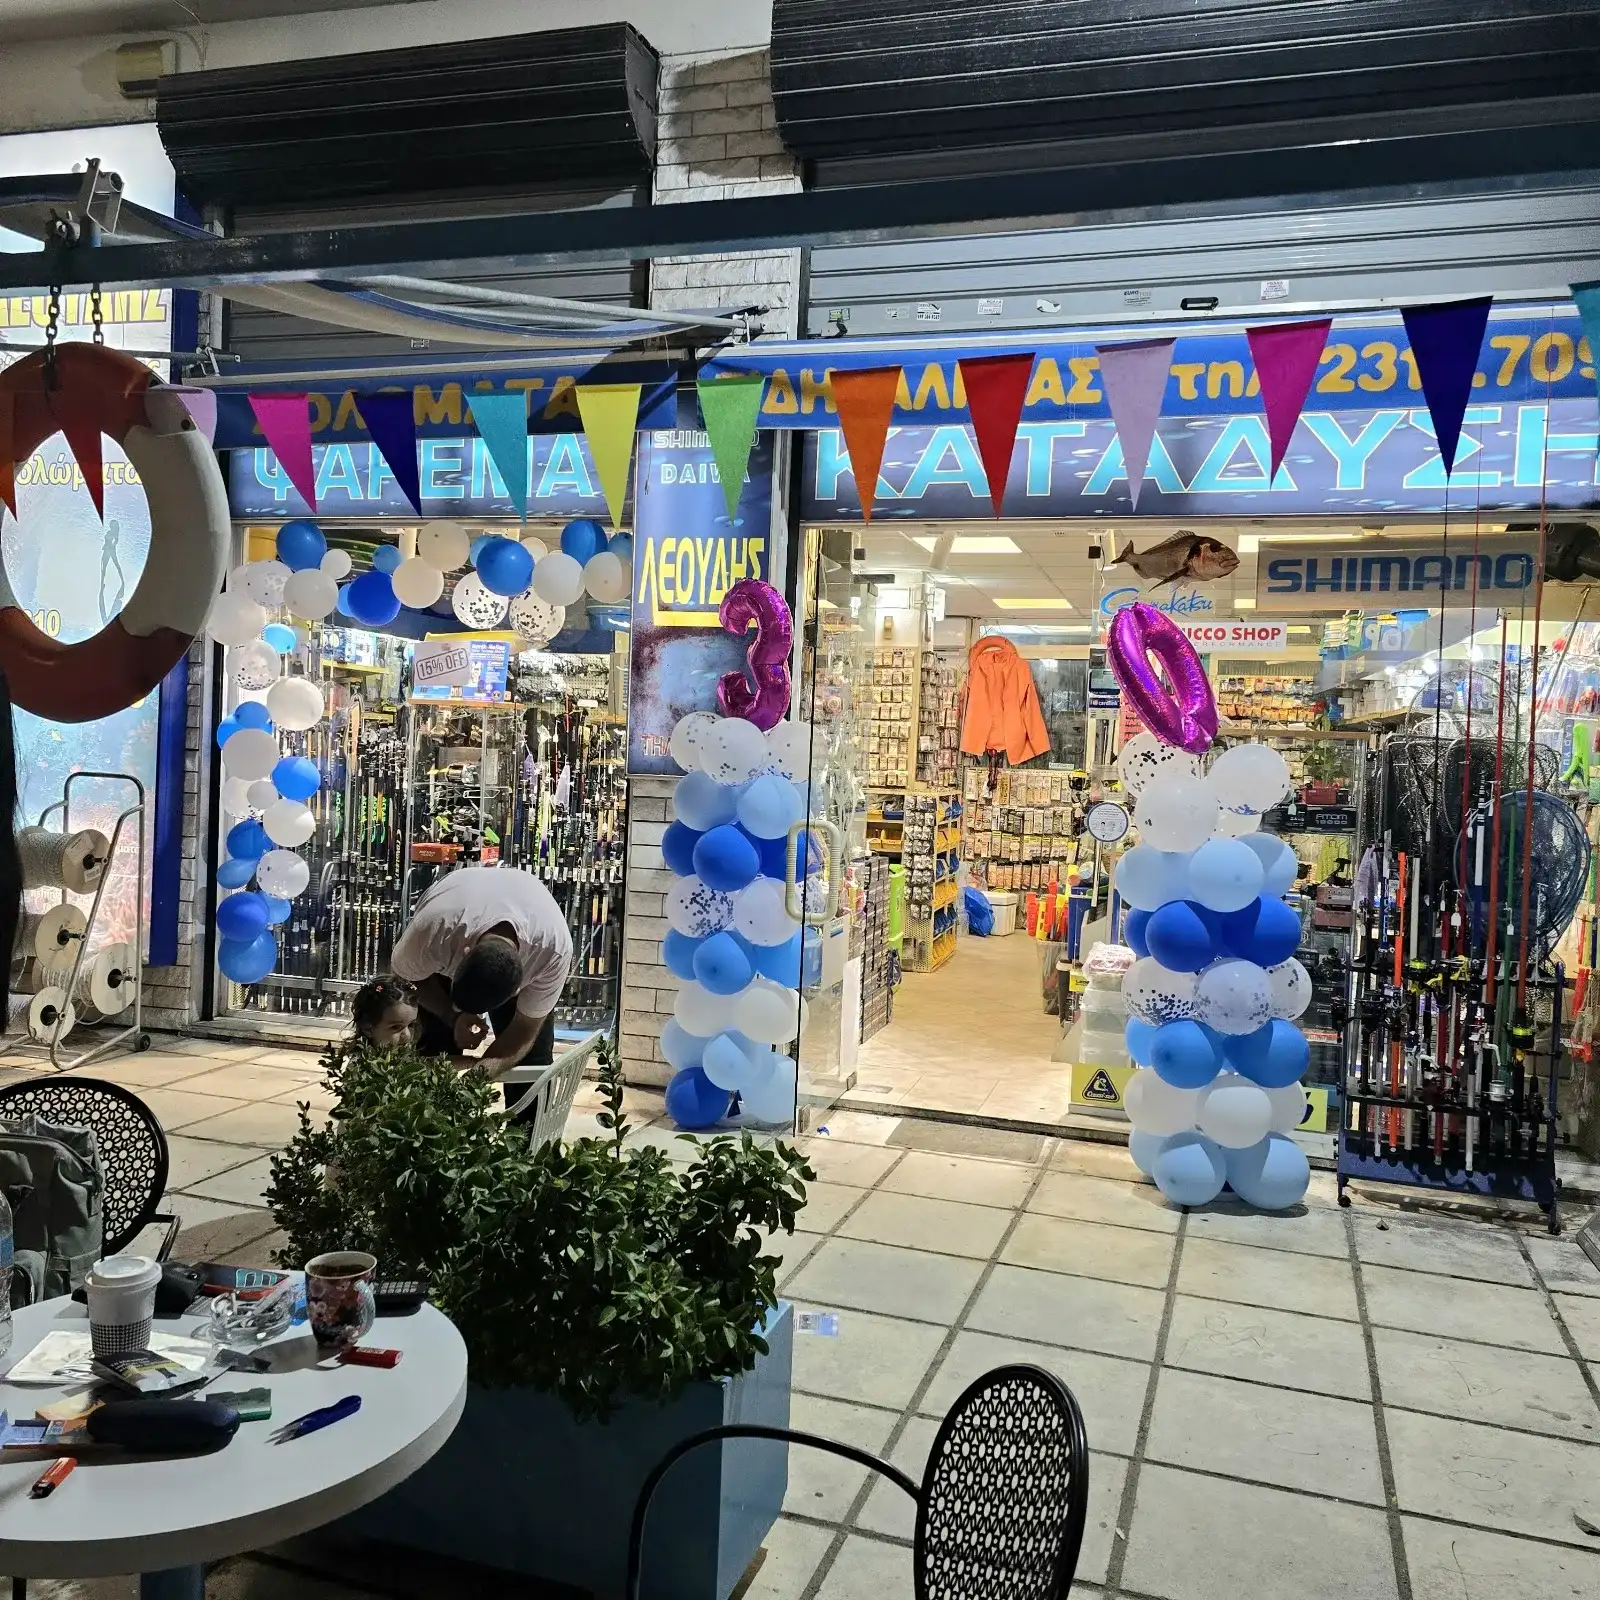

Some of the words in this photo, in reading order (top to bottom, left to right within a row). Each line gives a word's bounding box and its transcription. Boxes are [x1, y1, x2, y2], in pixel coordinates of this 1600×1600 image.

[660, 463, 750, 484] DAIW
[1267, 552, 1534, 593] SHIMANO
[1231, 627, 1281, 641] SHOP
[419, 657, 444, 678] 15%
[445, 649, 465, 670] OFF
